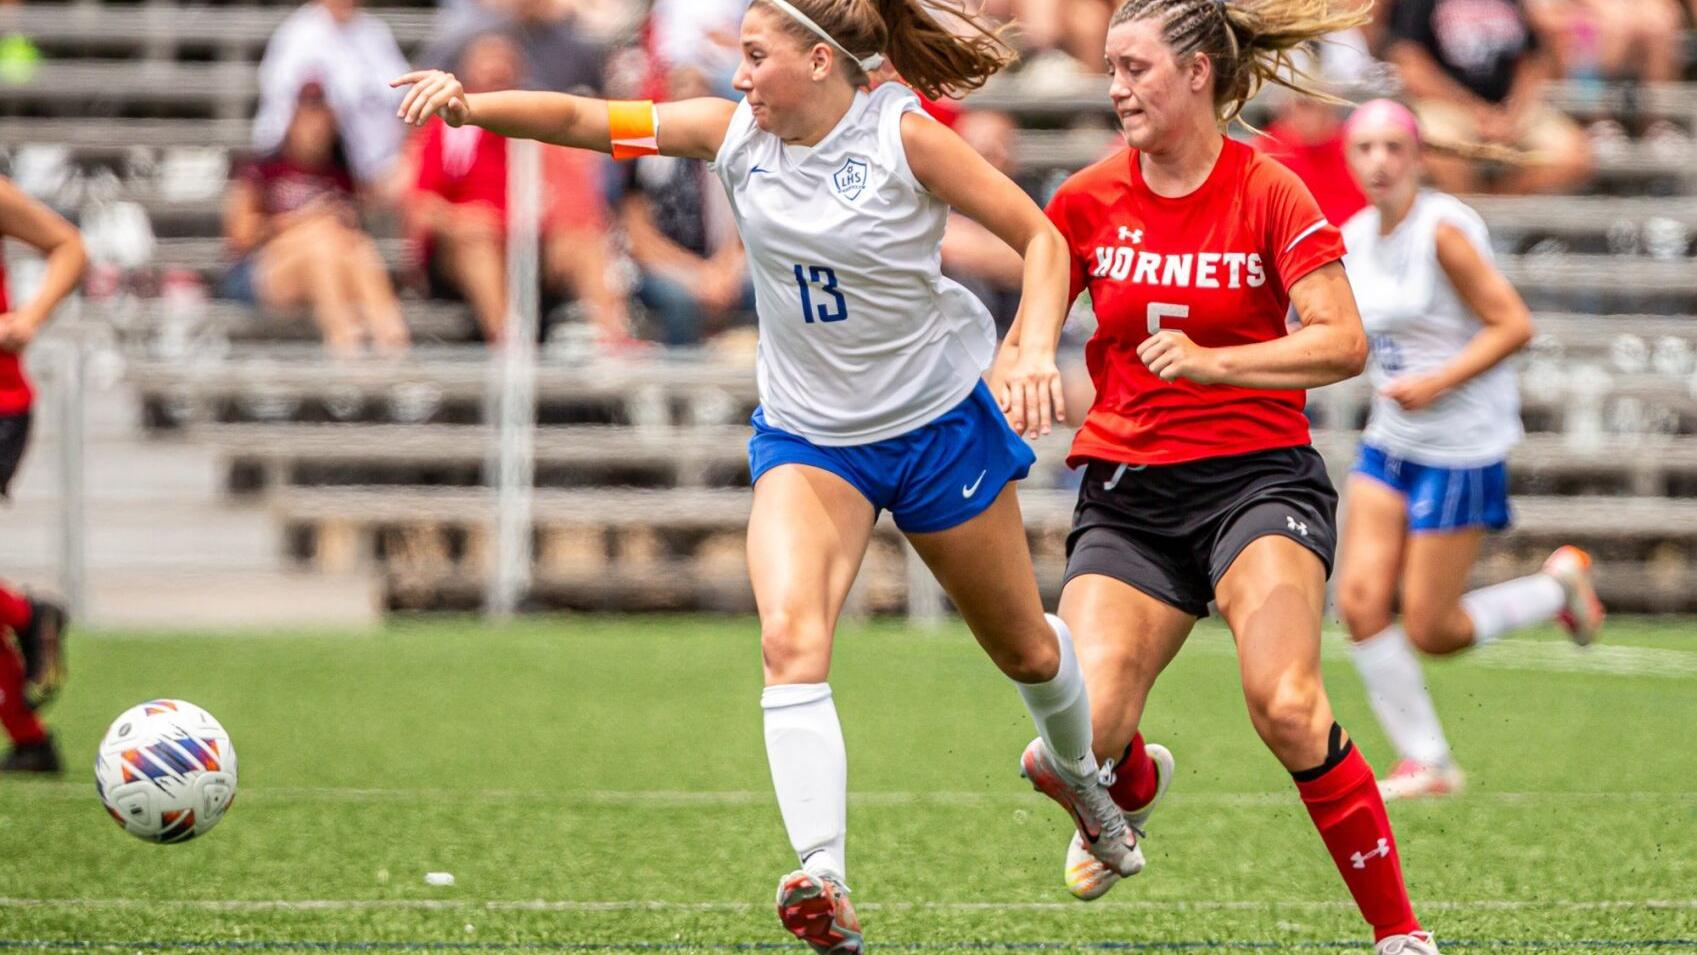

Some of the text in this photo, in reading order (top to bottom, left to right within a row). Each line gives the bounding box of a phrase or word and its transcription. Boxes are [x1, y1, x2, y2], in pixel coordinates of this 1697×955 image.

[841, 171, 862, 187] LHS
[1092, 246, 1266, 288] HORNETS
[794, 263, 848, 324] 13
